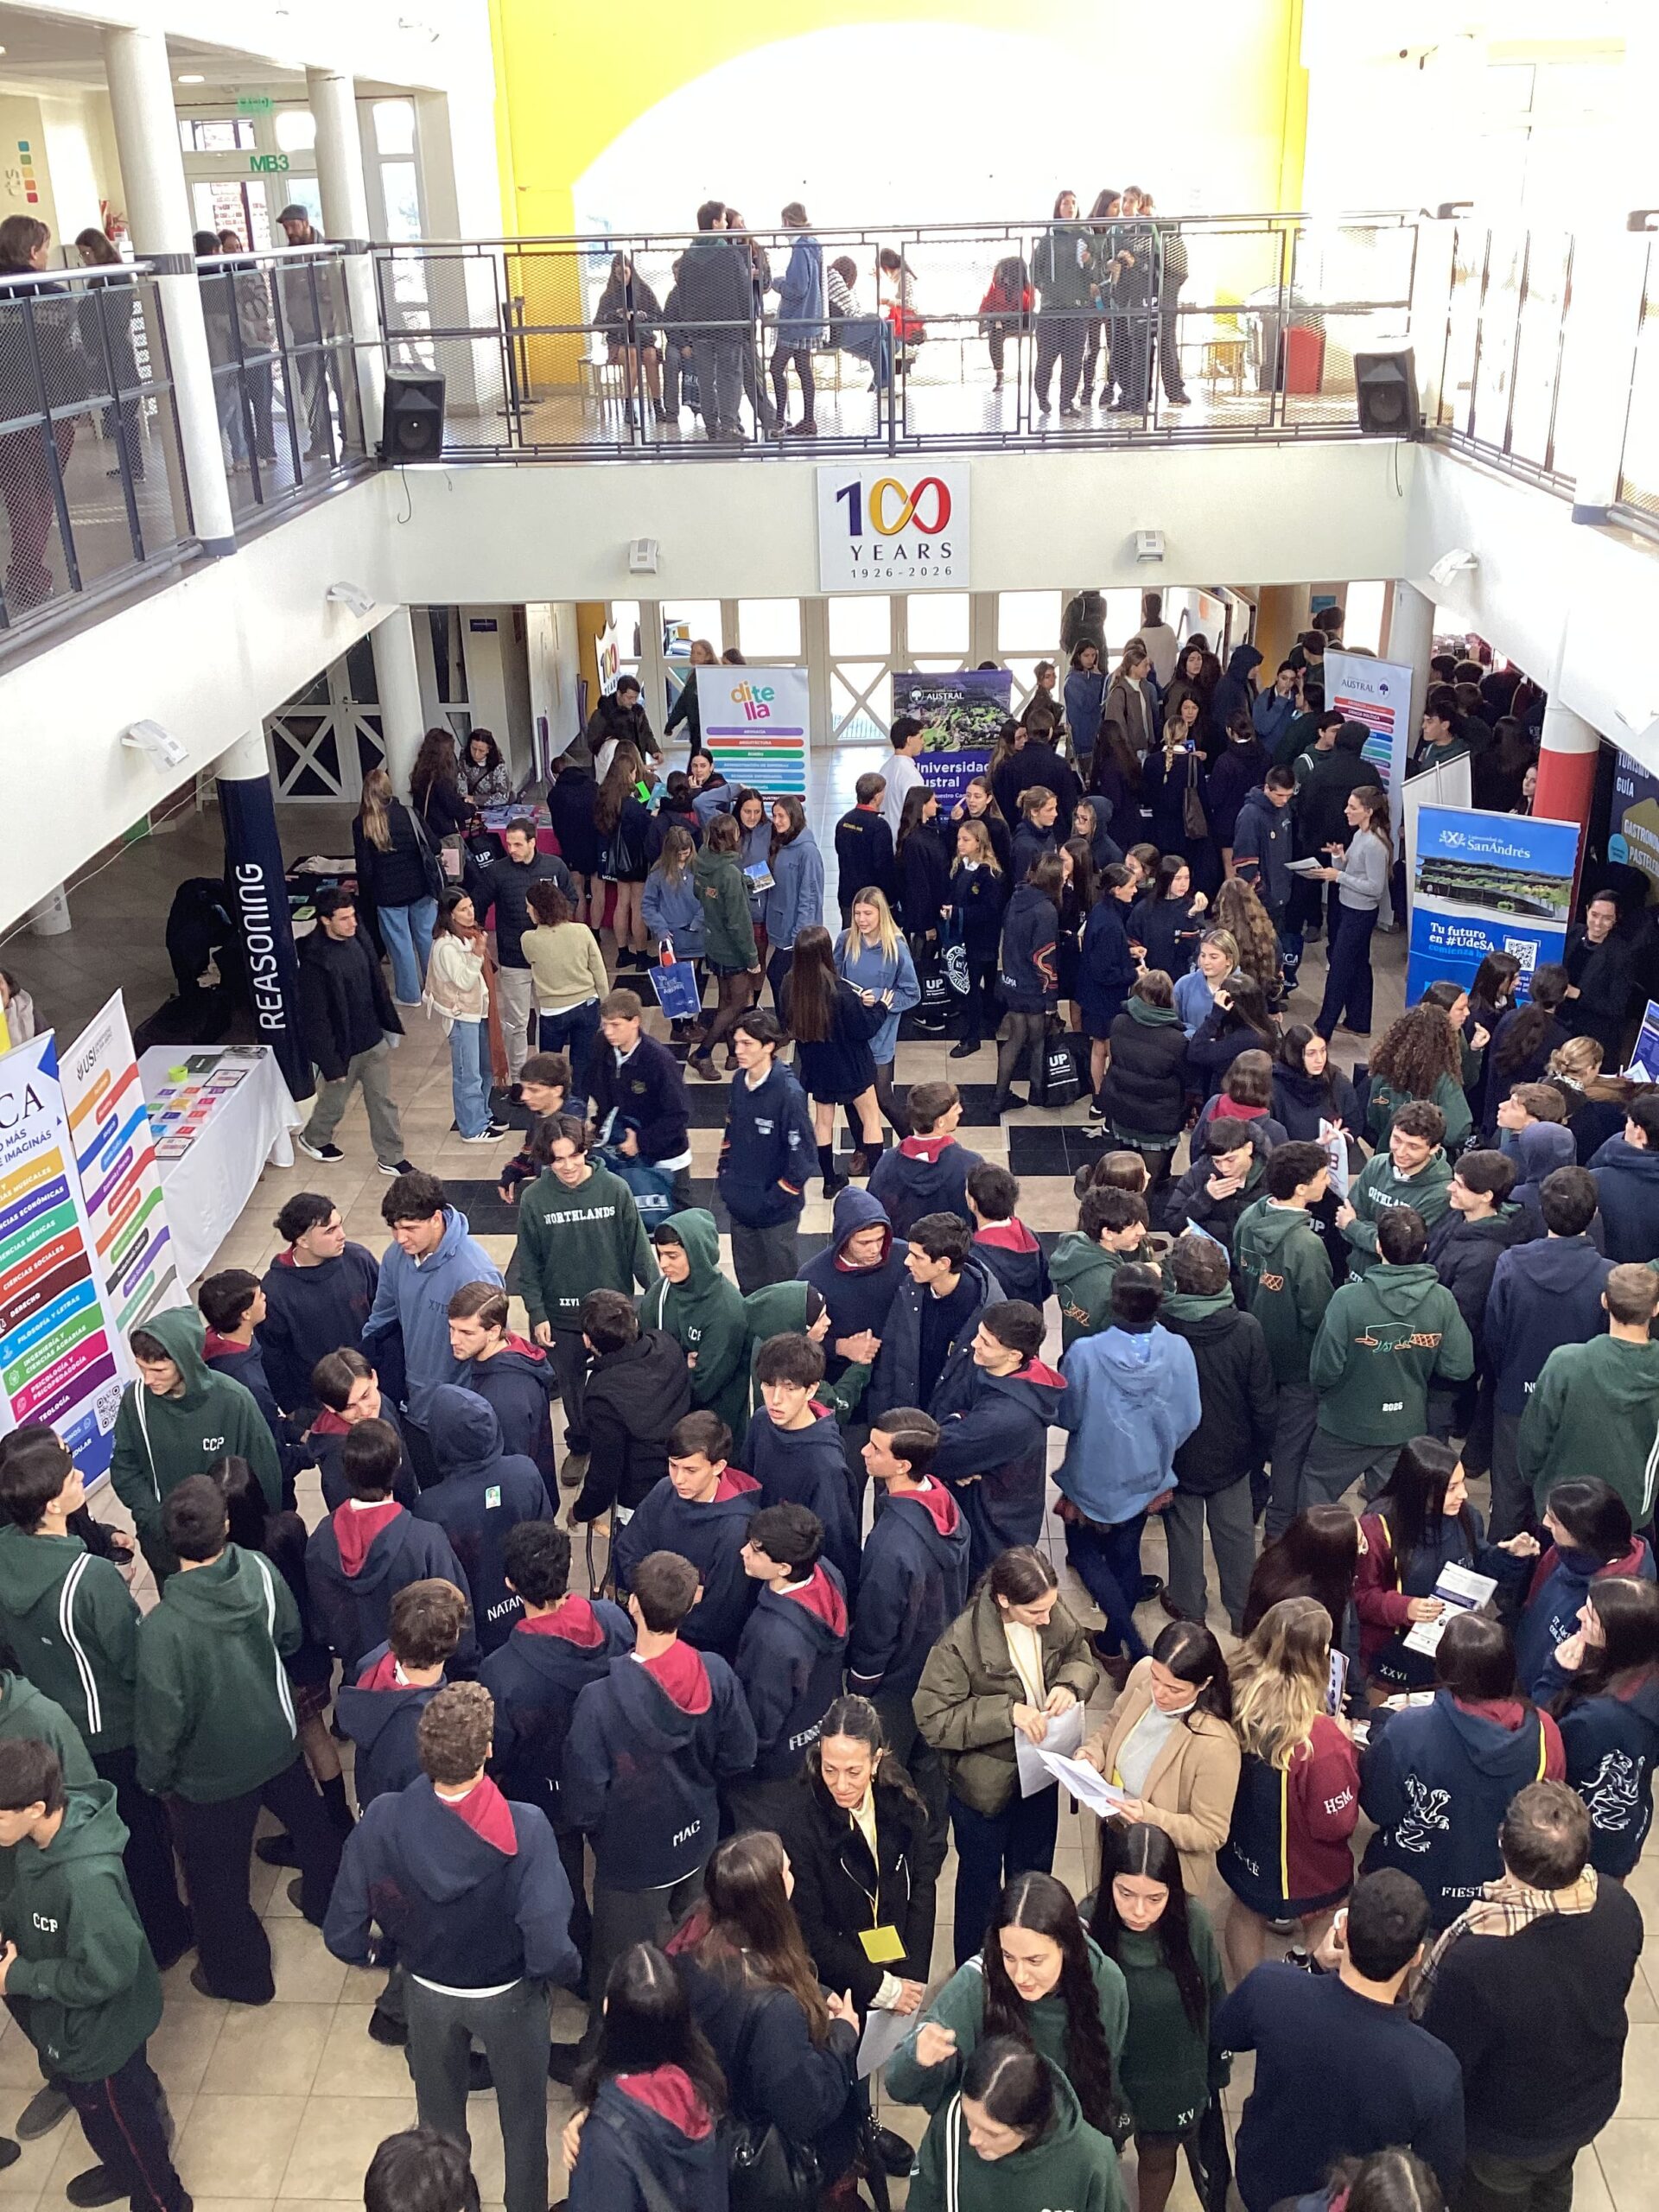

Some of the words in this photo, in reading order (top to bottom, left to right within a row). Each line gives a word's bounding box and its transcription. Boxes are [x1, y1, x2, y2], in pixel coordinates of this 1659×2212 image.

[250, 155, 289, 171] MB3
[836, 477, 951, 536] 100
[850, 542, 952, 561] YEARS
[851, 567, 952, 578] 1926-2026
[1341, 678, 1375, 693] AUSTRAL
[926, 692, 964, 701] AUSTRAL
[923, 776, 960, 788] ustral
[1617, 777, 1634, 798] GUÍA
[475, 851, 491, 862] UP
[1430, 922, 1445, 934] Tu
[1447, 925, 1485, 939] futuro
[236, 864, 286, 1029] REASONING
[1429, 935, 1443, 944] en
[1446, 938, 1495, 952] #UdeSA
[926, 978, 944, 989] UP
[83, 1046, 97, 1074] USI
[1049, 1053, 1068, 1067] UP
[4, 1130, 52, 1163] IMAGINÁS
[6, 1128, 27, 1147] MÁS
[13, 1166, 52, 1193] MUSICALES
[19, 1185, 65, 1217] ECONÓMICAS
[544, 1206, 616, 1225] NORTHLANDS
[26, 1220, 56, 1243] MÉDICAS
[3, 1267, 33, 1291] CIENCIAS
[33, 1244, 66, 1269] SOCIALES
[10, 1293, 41, 1318] DERECHO
[559, 1298, 580, 1306] XXVI
[17, 1318, 51, 1344] FILOSOFÍA
[56, 1295, 80, 1315] LETRAS
[22, 1338, 60, 1367] INGENIERÍA
[25, 1351, 55, 1375] CIENCIAS
[55, 1325, 86, 1351] AGRARIAS
[30, 1362, 69, 1393] PSICOLOGÍA
[33, 1356, 86, 1401] PSICOPEDAGOGÍA
[38, 1395, 71, 1422] TEOLOGÍA
[203, 1436, 225, 1452] CCP
[1380, 1663, 1408, 1681] XXVI
[1323, 1785, 1354, 1815] HSM
[673, 1820, 701, 1847] MAC
[1441, 1886, 1484, 1898] FIEST
[33, 1912, 58, 1933] CCP
